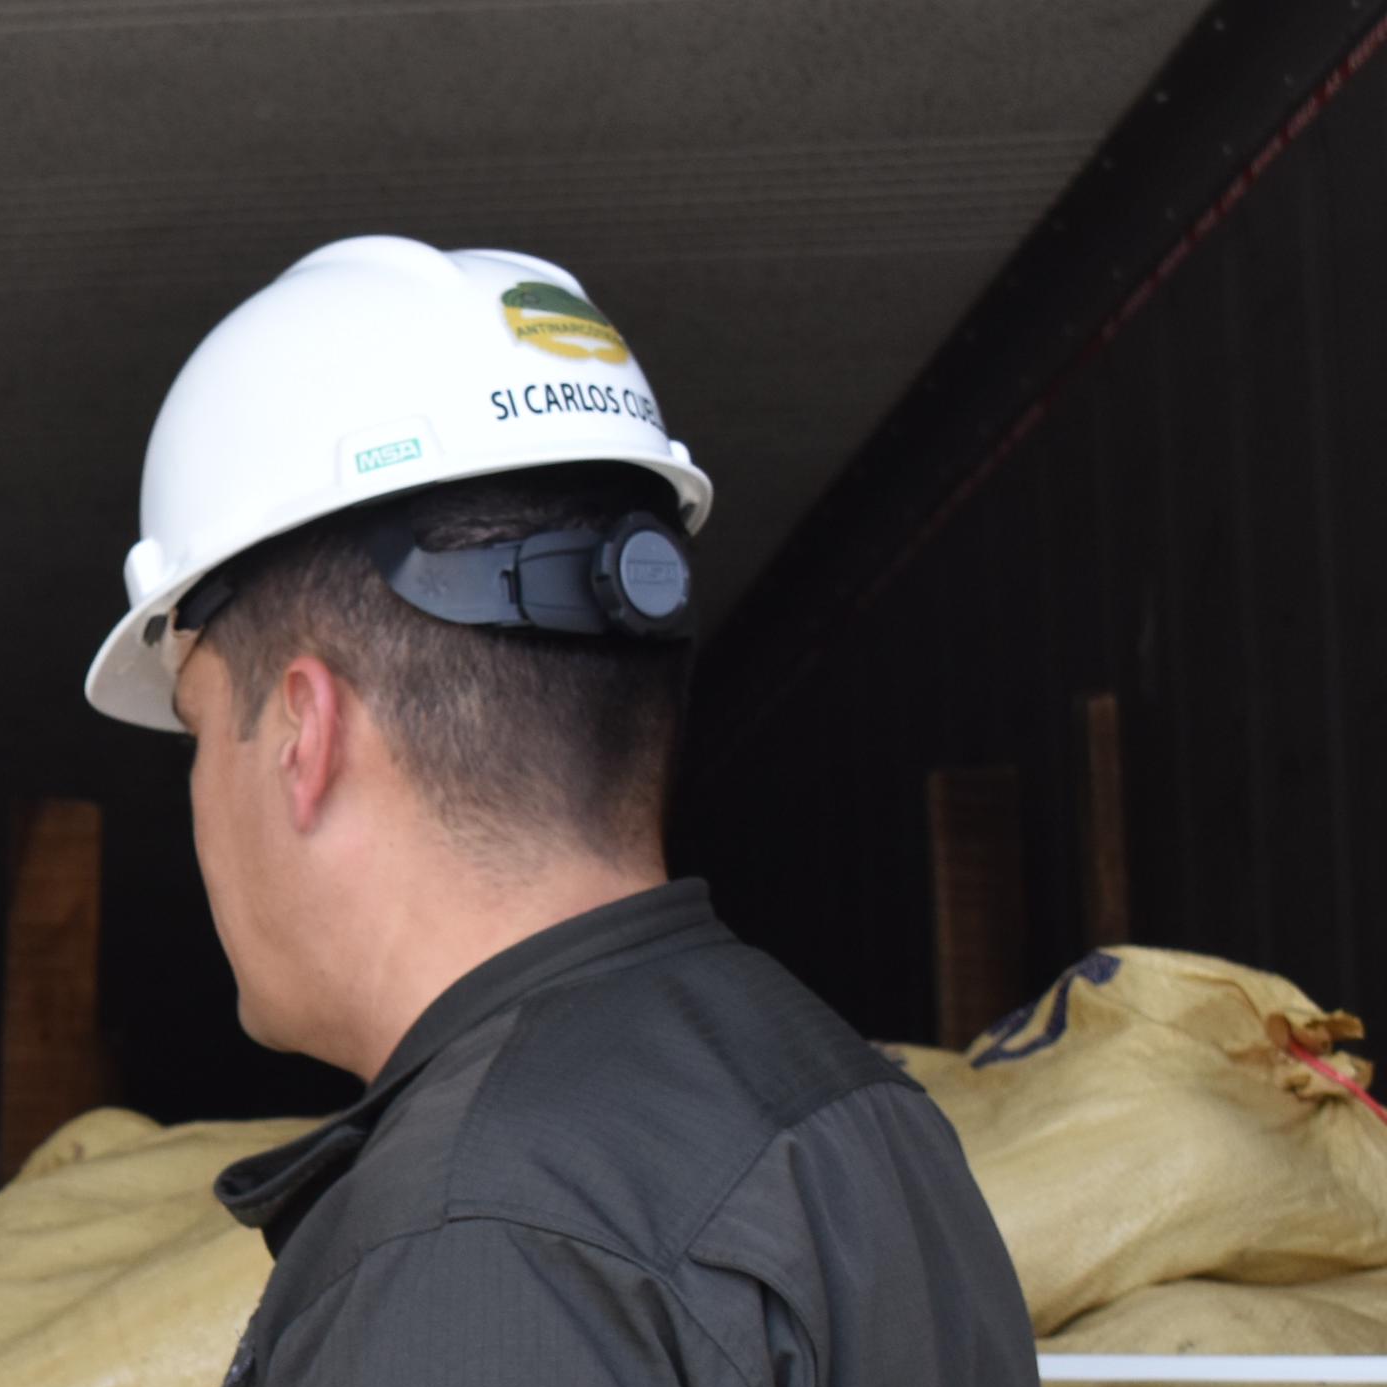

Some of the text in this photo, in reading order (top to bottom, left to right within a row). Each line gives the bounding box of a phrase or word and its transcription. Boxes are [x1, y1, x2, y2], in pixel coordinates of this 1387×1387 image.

[491, 389, 518, 420] SI
[524, 383, 620, 414] CARLOS
[358, 440, 420, 472] MSA
